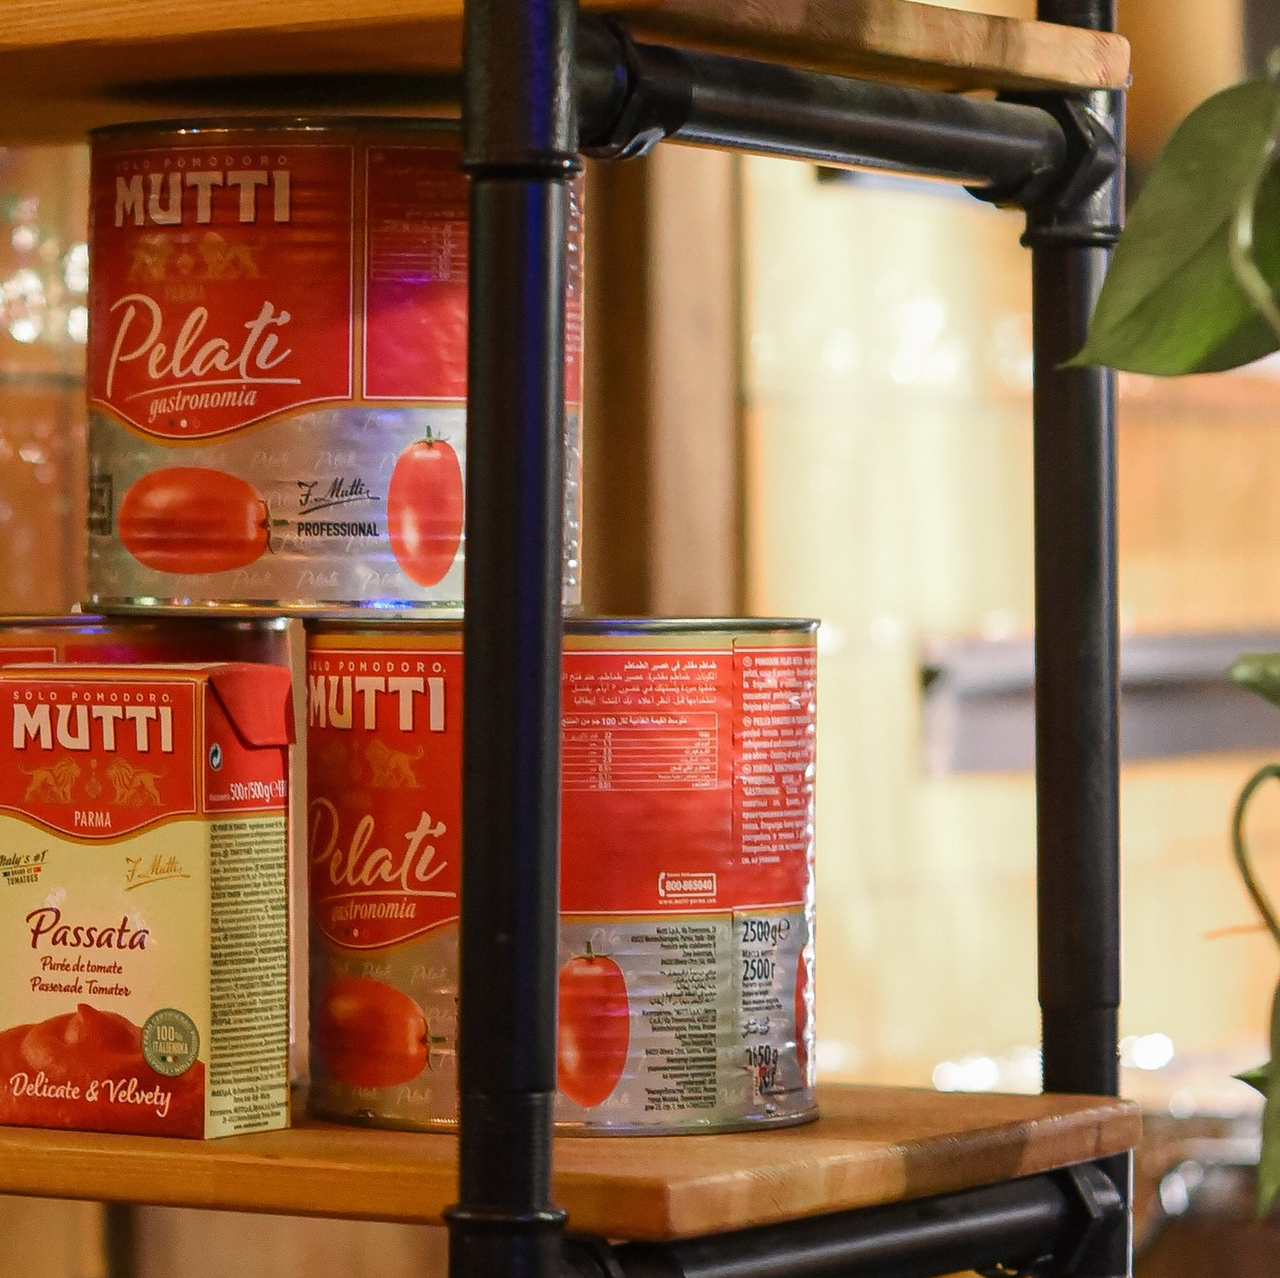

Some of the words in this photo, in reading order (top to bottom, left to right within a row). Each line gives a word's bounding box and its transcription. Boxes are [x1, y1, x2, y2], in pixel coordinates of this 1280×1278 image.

[115, 171, 290, 227] MUTTI
[107, 293, 296, 399] Pelati
[149, 385, 257, 423] gastronomia
[297, 522, 380, 538] PROFESSIONAL
[338, 661, 447, 673] POMODORO.
[13, 690, 57, 701] SOLO
[71, 691, 173, 703] POMODORO.
[309, 675, 445, 731] MUTTI
[12, 703, 173, 752] MUTTI
[74, 810, 112, 828] PARMA
[309, 797, 452, 894] Pelati
[7, 874, 39, 886] TOMATOES
[25, 907, 150, 950] Passata
[40, 955, 71, 972] Purée
[72, 955, 85, 972] de
[86, 960, 123, 974] tomate
[30, 976, 84, 994] Passerade
[86, 980, 132, 997] Tomater
[9, 1071, 81, 1100] Delicate
[85, 1080, 99, 1102] &
[101, 1077, 172, 1118] Velvety
